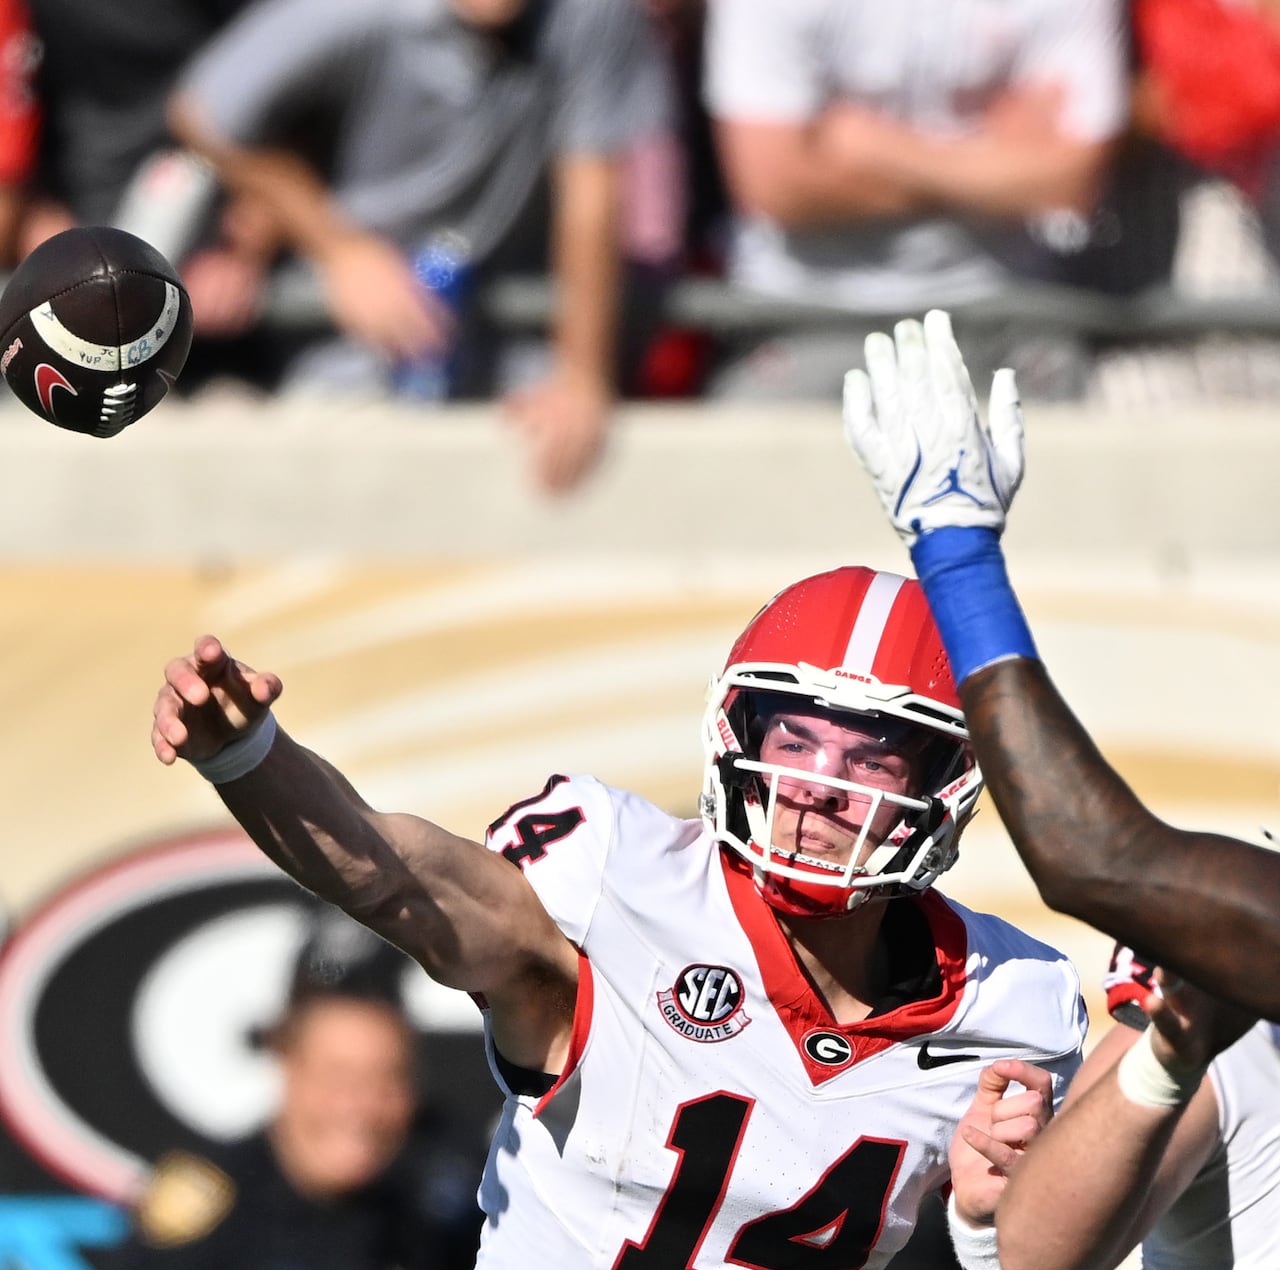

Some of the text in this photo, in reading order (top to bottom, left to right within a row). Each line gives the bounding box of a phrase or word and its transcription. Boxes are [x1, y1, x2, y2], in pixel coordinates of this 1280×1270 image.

[679, 966, 739, 1021] SEC
[663, 1002, 734, 1041] GRADUATE
[805, 1031, 853, 1066] G
